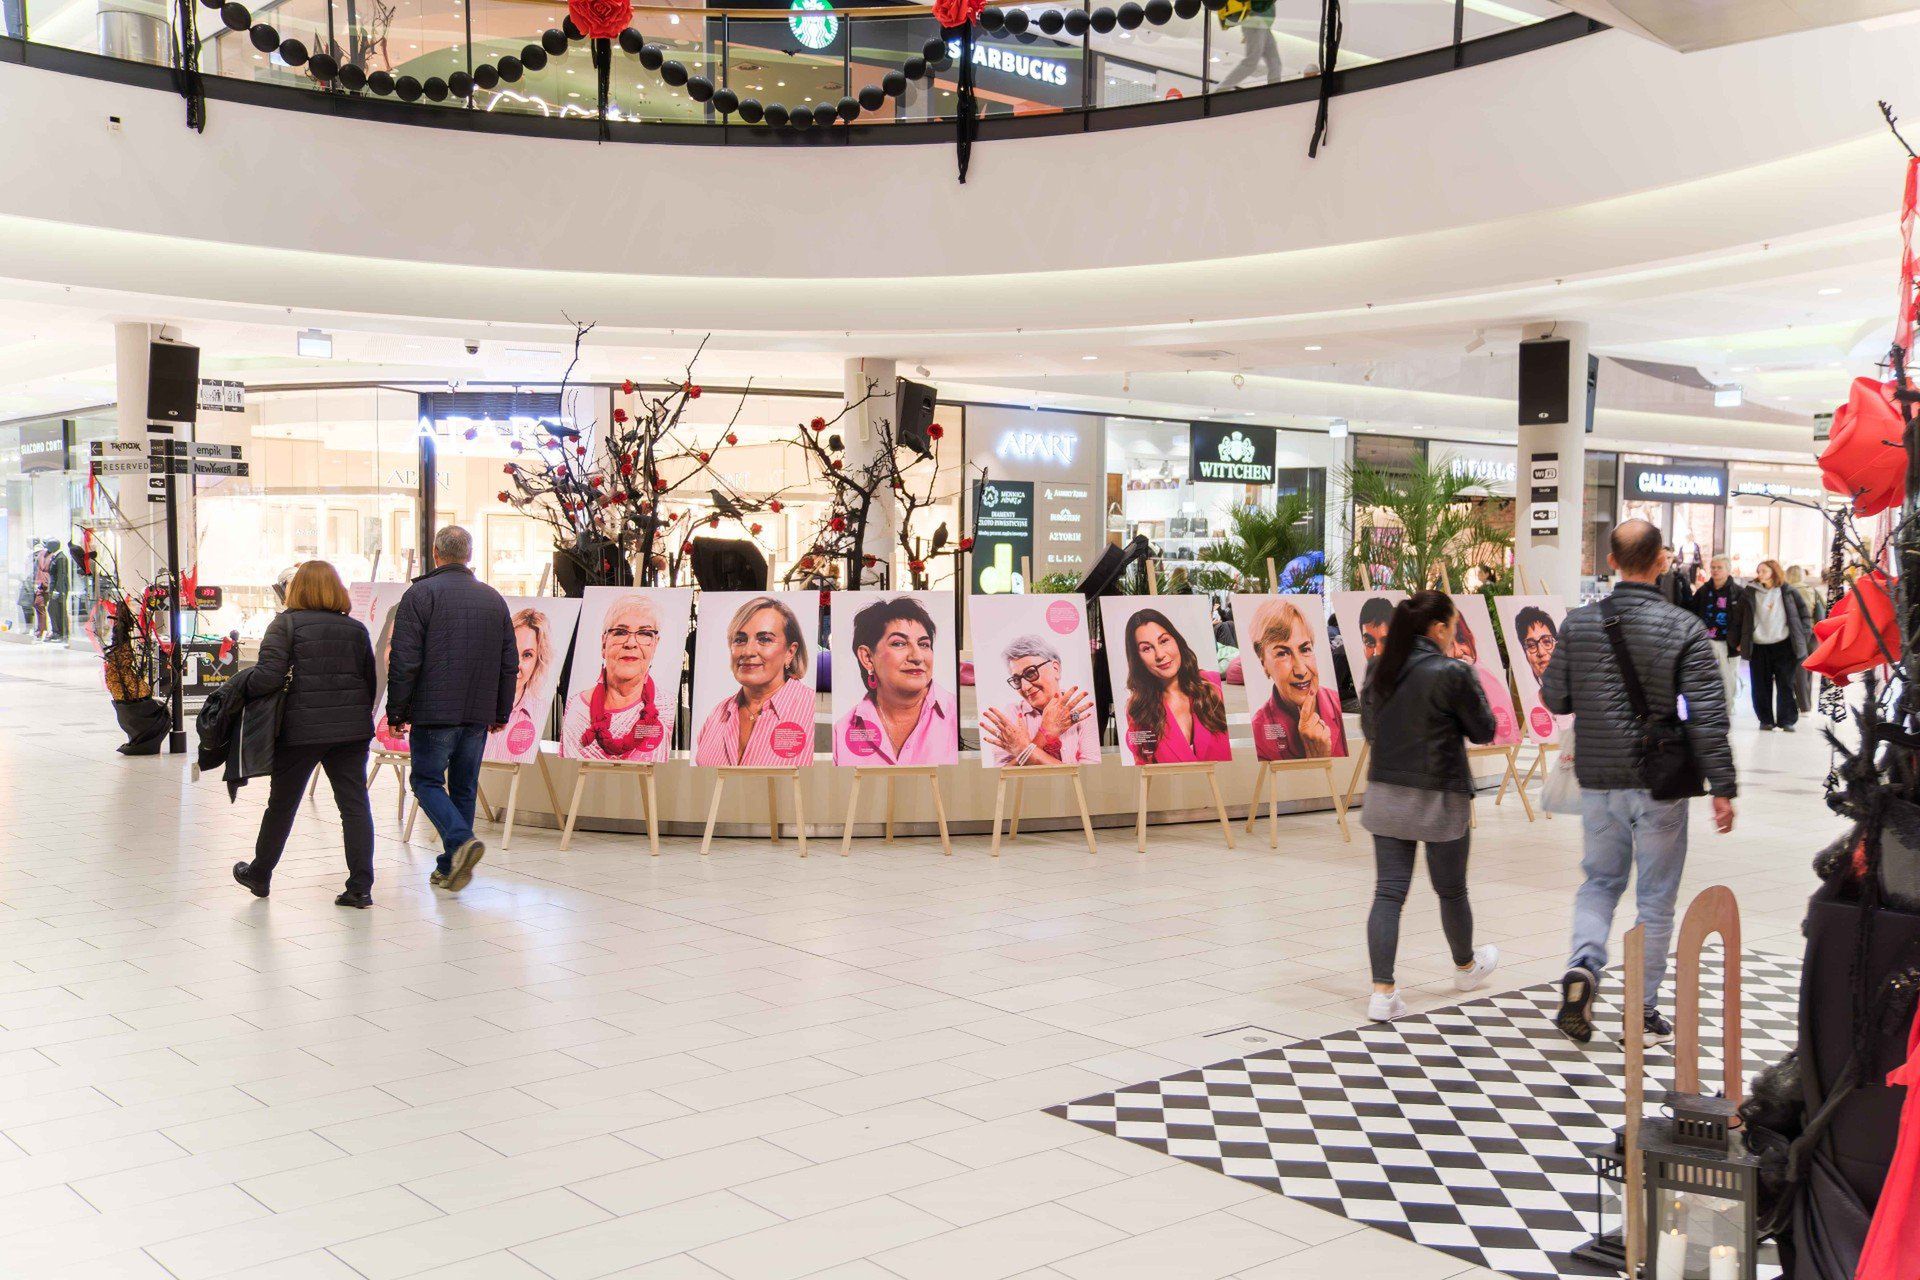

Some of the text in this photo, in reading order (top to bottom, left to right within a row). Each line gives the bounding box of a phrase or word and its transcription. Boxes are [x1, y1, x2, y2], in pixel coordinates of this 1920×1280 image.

[947, 40, 1067, 86] SARBUCKS
[196, 445, 222, 457] empik
[1001, 431, 1077, 464] APART
[103, 462, 149, 471] RESERVED
[1199, 461, 1272, 482] WITTCHEN
[387, 469, 450, 491] APRT
[1638, 472, 1720, 497] CALZEDONIA
[1048, 554, 1082, 563] ELIKA
